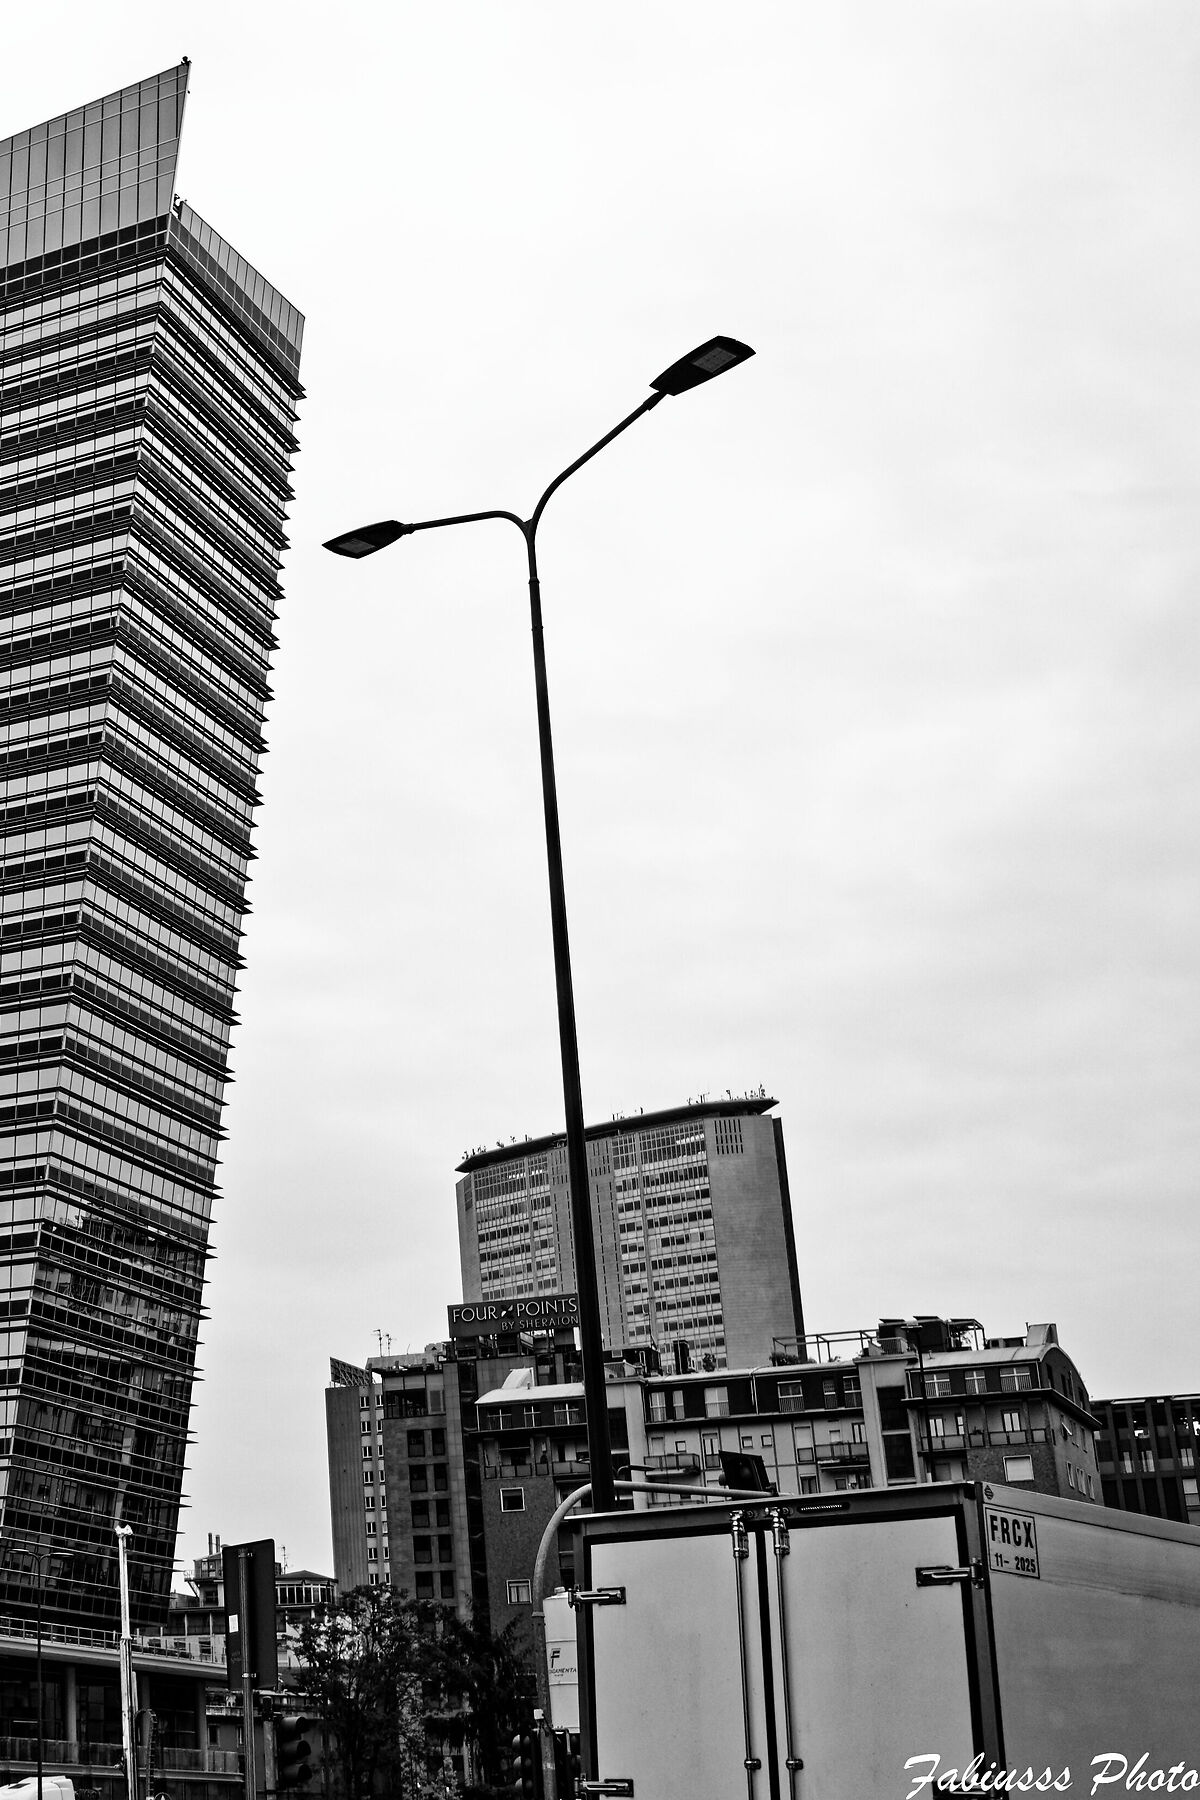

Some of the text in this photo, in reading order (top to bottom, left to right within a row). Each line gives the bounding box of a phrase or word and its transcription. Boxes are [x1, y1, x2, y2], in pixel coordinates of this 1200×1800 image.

[452, 1297, 578, 1323] FOUR POINTS
[501, 1315, 579, 1331] BY SHERATON
[989, 1514, 1034, 1549] FRCX
[1014, 1555, 1036, 1574] 2025
